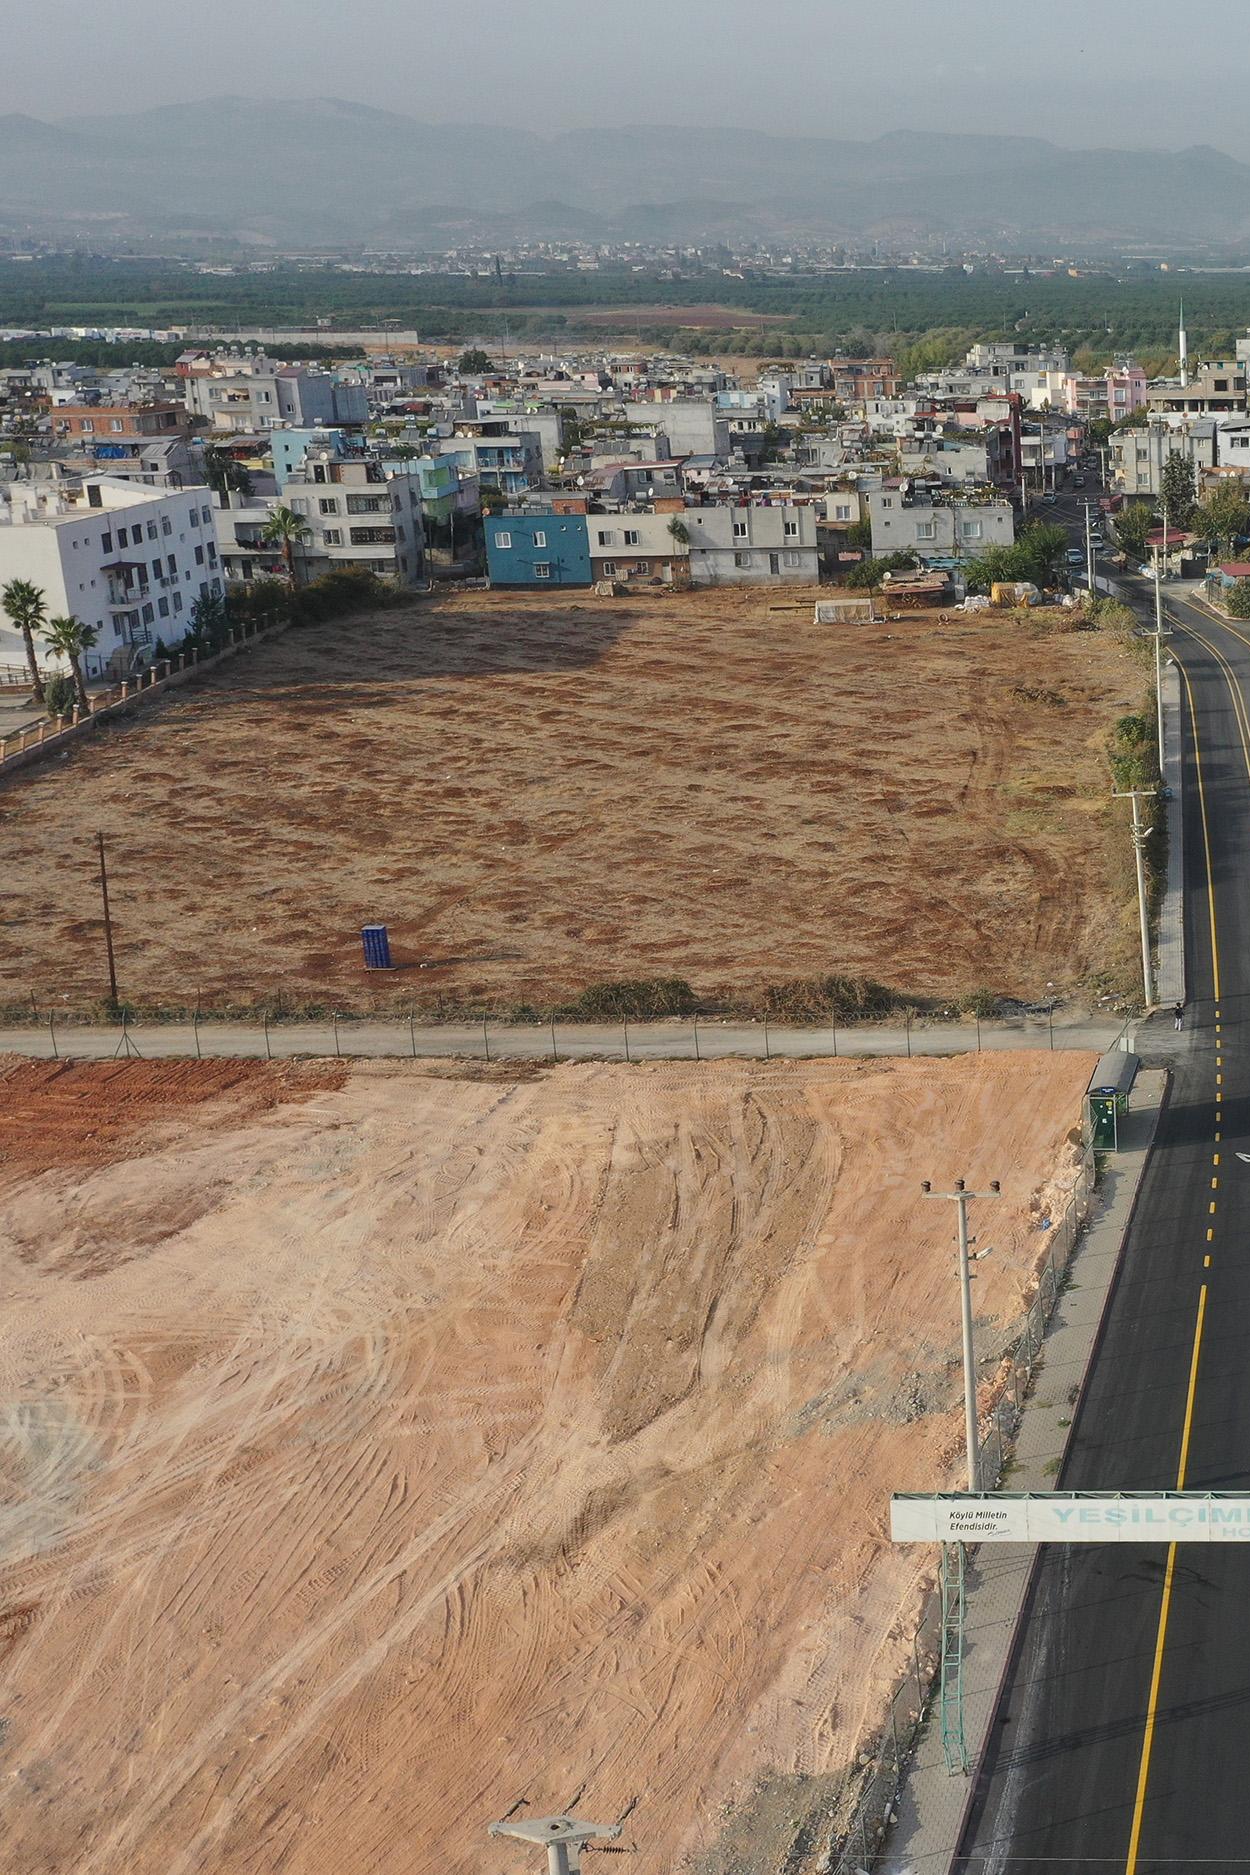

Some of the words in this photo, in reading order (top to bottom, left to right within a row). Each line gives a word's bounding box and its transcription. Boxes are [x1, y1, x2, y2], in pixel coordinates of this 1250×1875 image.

[949, 1511, 973, 1521] Köylü
[975, 1511, 1008, 1520] Milletin
[949, 1522, 998, 1531] Efendisidir.
